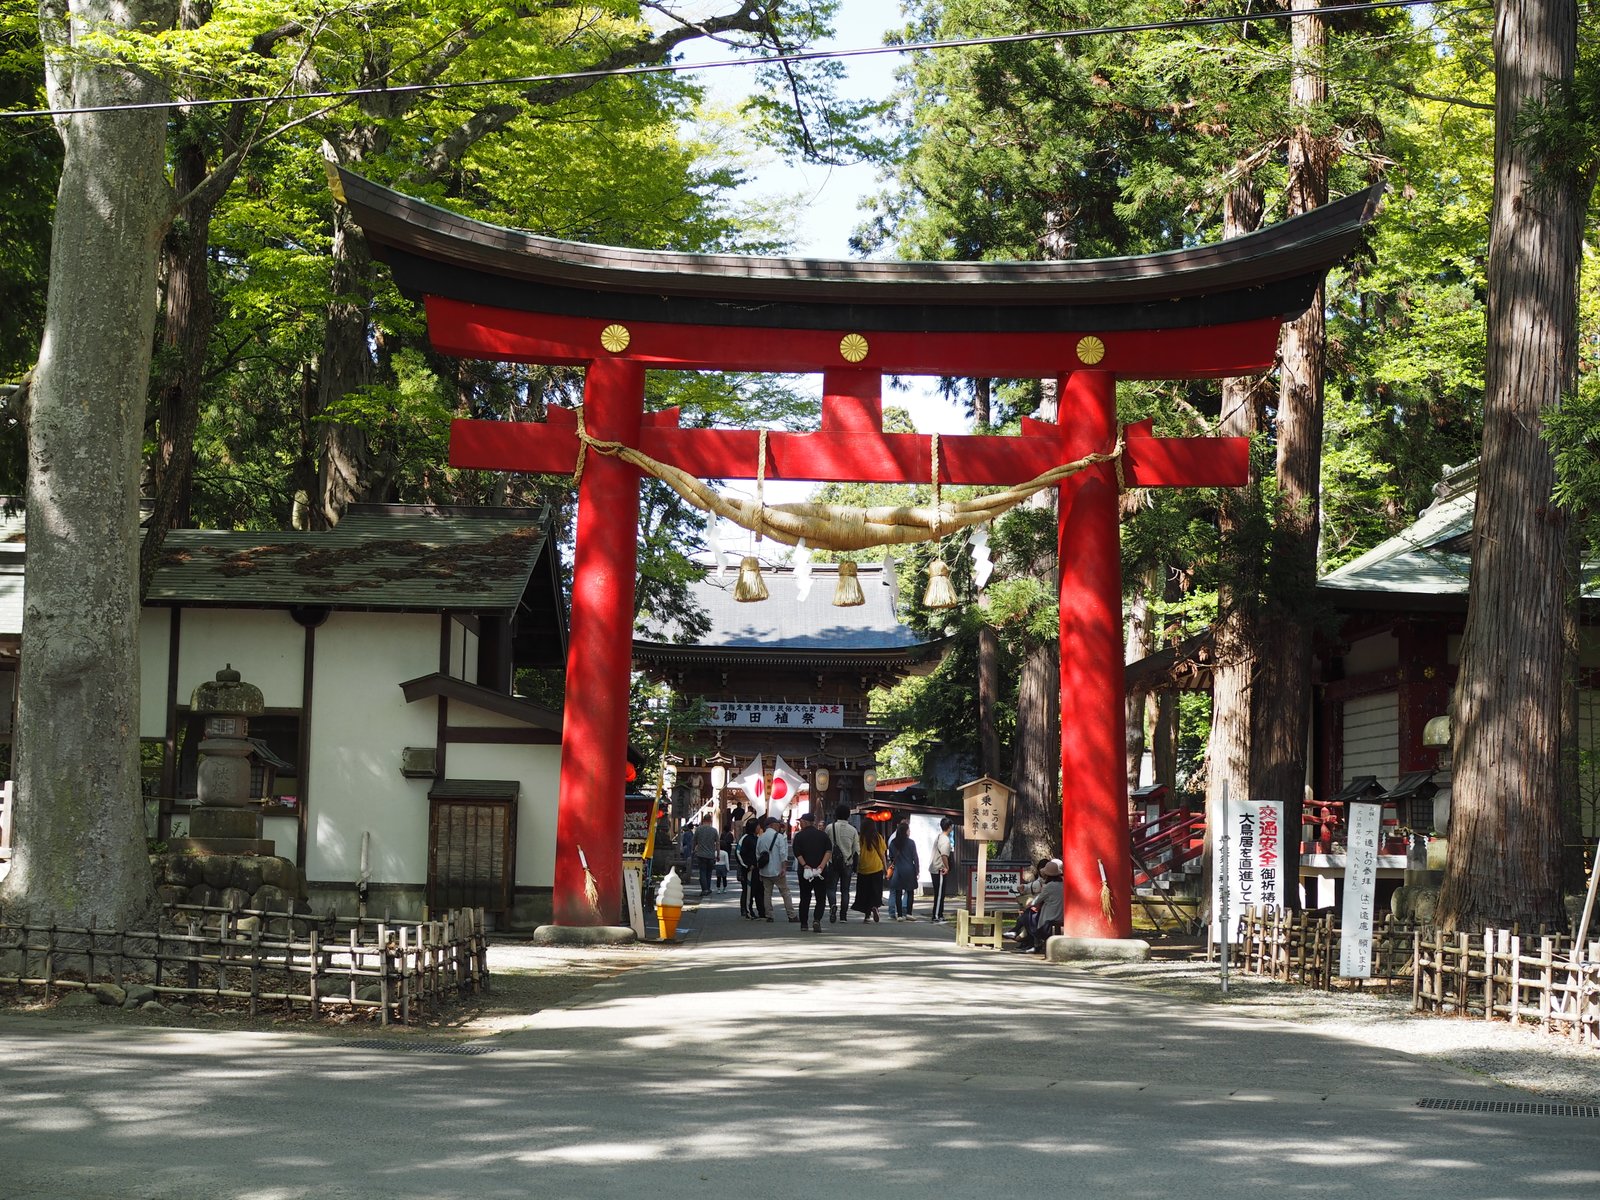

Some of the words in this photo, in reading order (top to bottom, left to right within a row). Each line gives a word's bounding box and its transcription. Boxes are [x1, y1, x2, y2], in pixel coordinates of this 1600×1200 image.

[723, 711, 816, 725] 御田植祭
[819, 705, 840, 714] 決定
[981, 782, 993, 807] 下乗
[991, 808, 999, 831] この先
